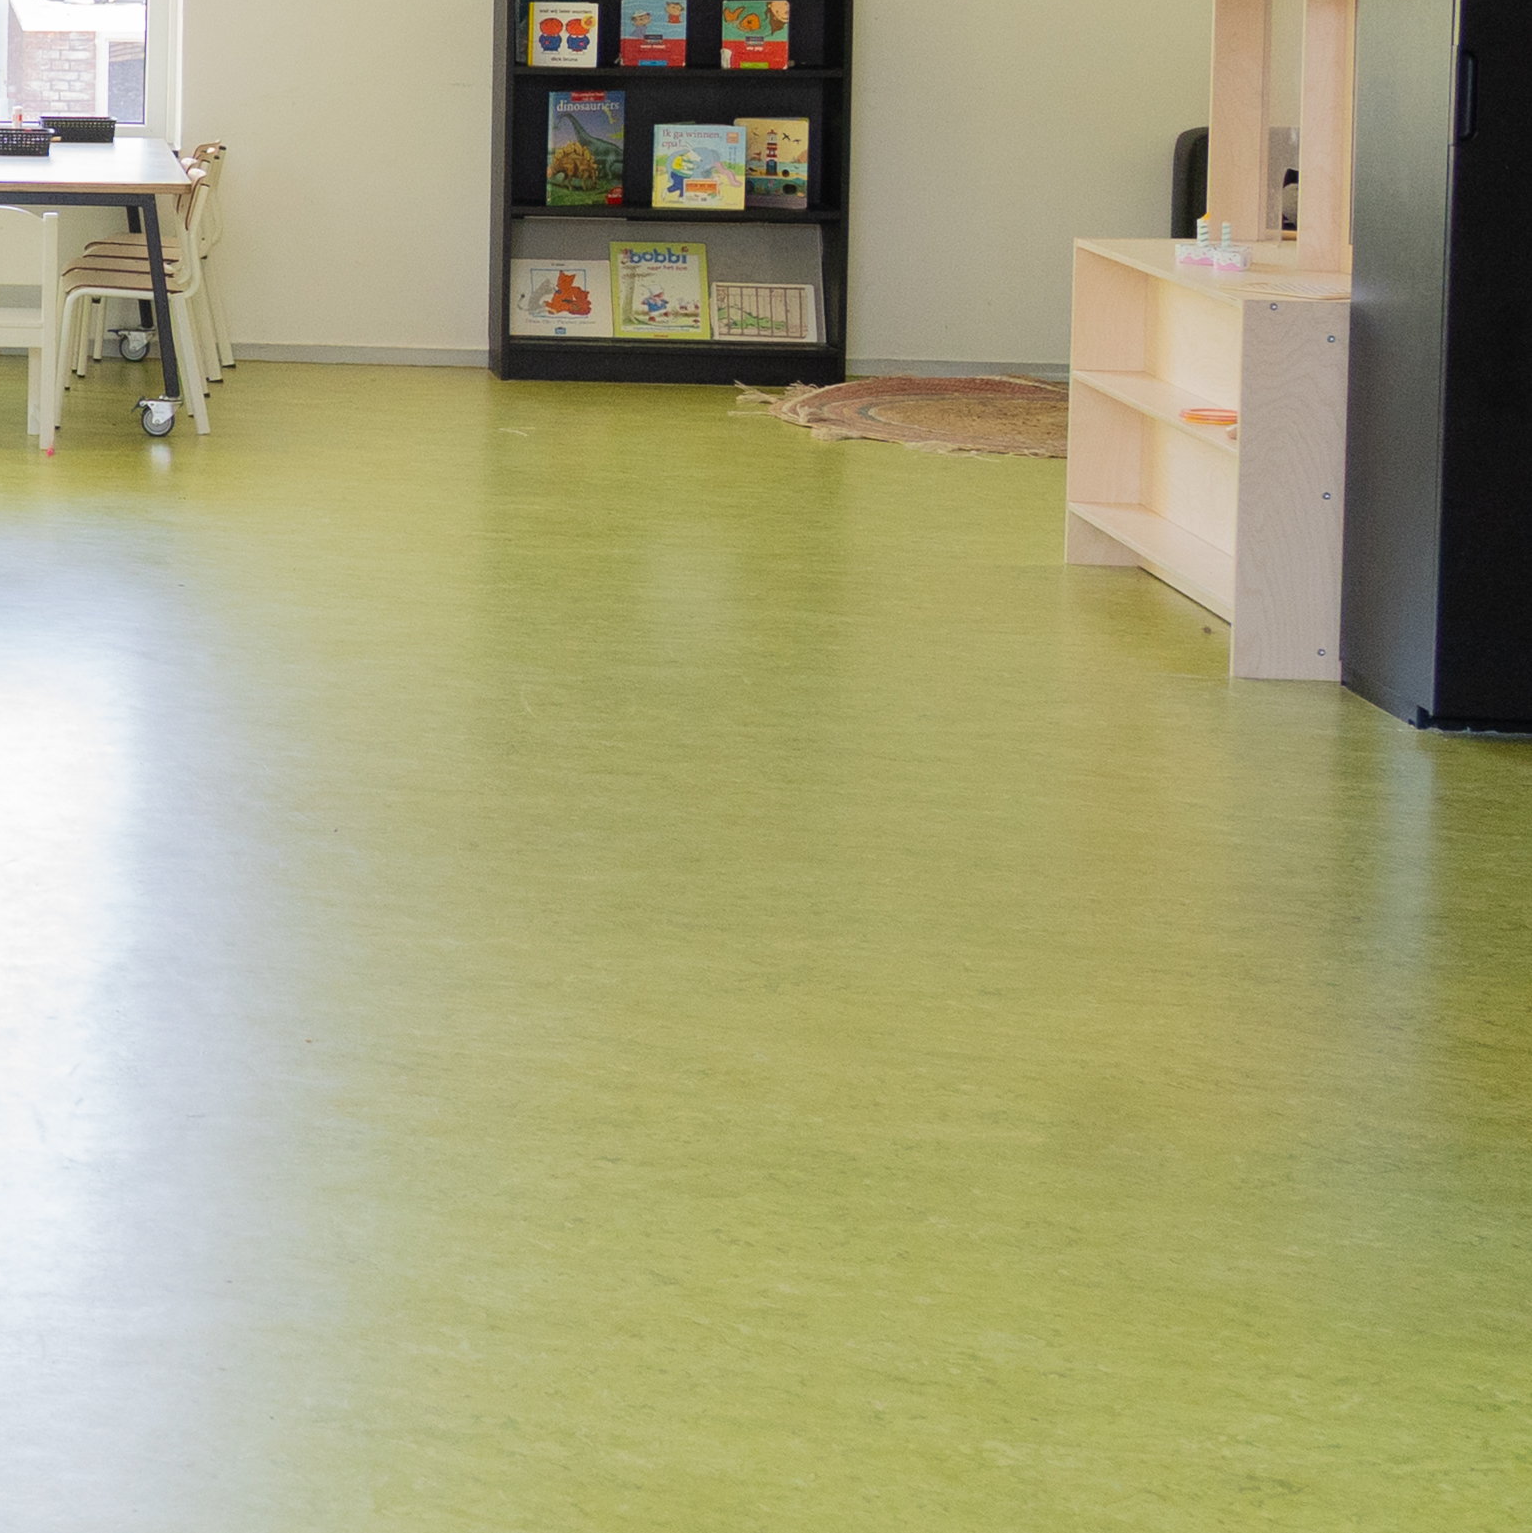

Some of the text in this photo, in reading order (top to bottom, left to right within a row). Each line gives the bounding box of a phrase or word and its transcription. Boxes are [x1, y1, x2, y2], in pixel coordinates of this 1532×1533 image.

[662, 128, 672, 138] Ik
[673, 131, 684, 140] ga
[629, 246, 689, 264] bobbi
